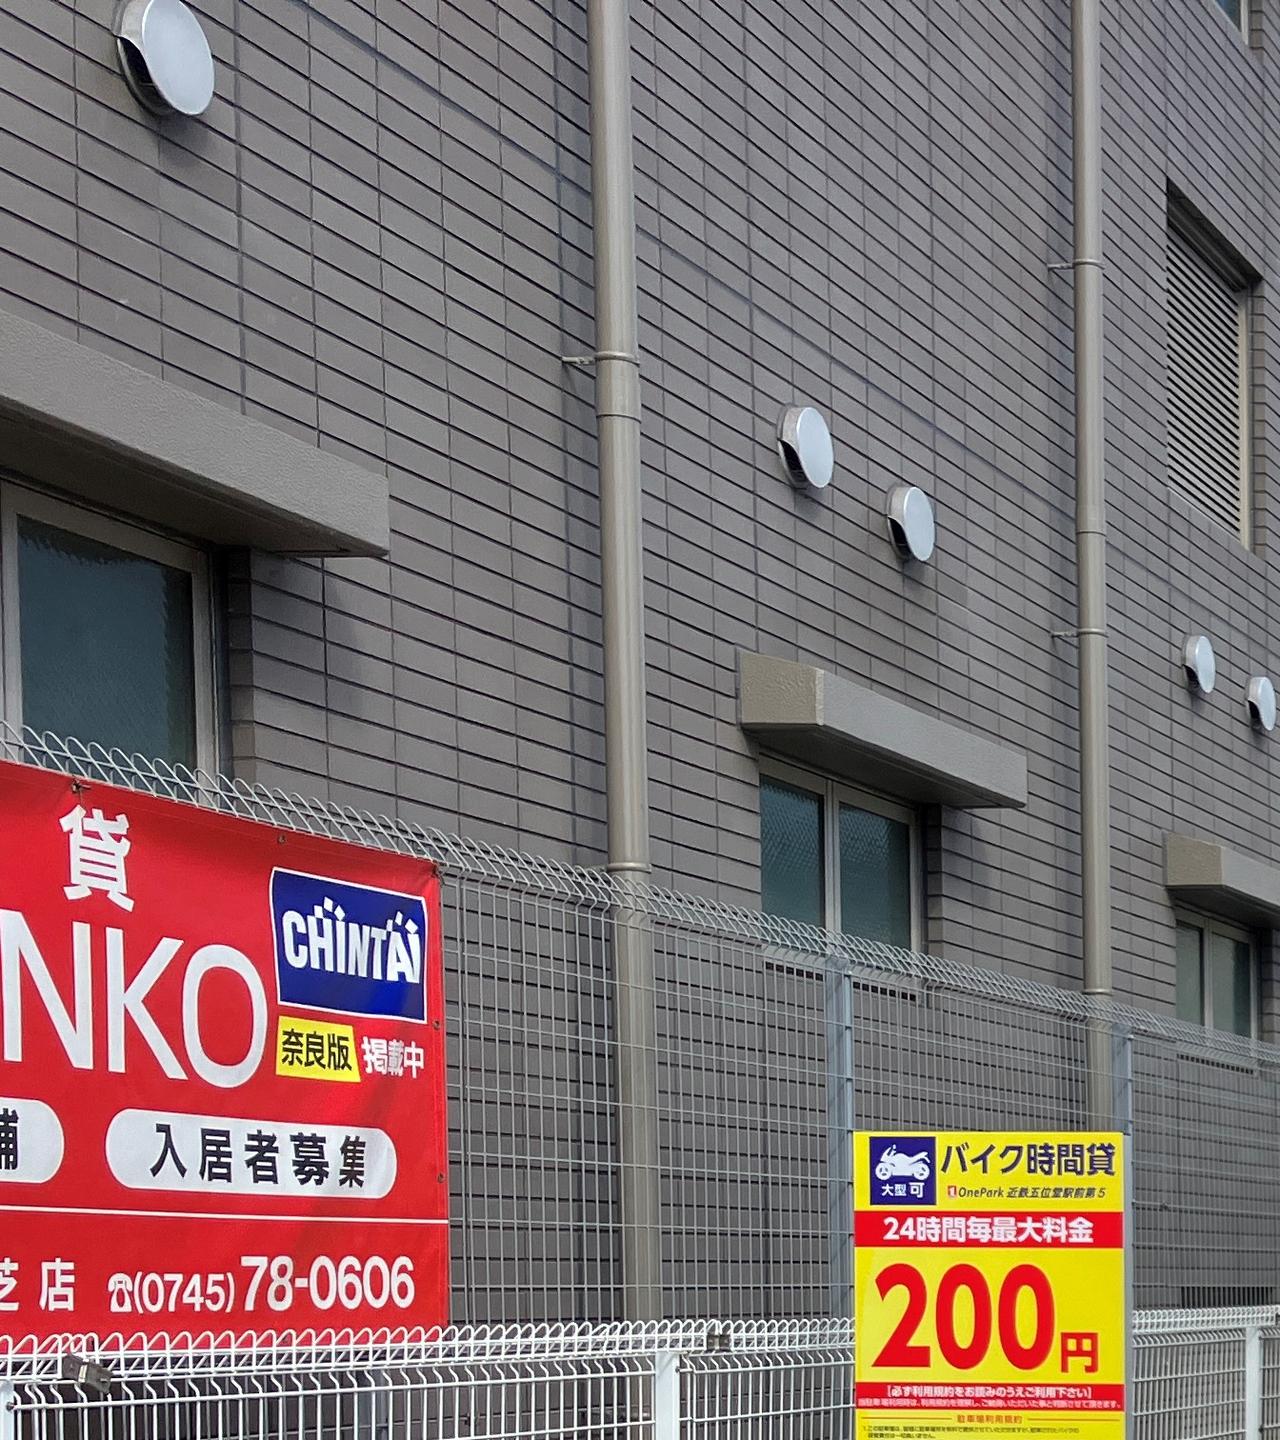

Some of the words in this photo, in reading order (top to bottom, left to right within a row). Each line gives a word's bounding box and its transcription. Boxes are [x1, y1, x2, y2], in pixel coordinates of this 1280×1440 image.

[59, 804, 135, 912] 貸
[281, 1028, 352, 1071] 奈良版
[361, 1036, 425, 1079] 掲載中
[149, 1123, 366, 1188] 入居者募集
[940, 1142, 1116, 1177] バイク時間貸
[958, 1186, 1004, 1198] OnePark
[883, 1216, 1094, 1243] 24時間毎最大料金
[134, 1255, 415, 1314] (0745)78-0606
[872, 1263, 1098, 1373] 200円
